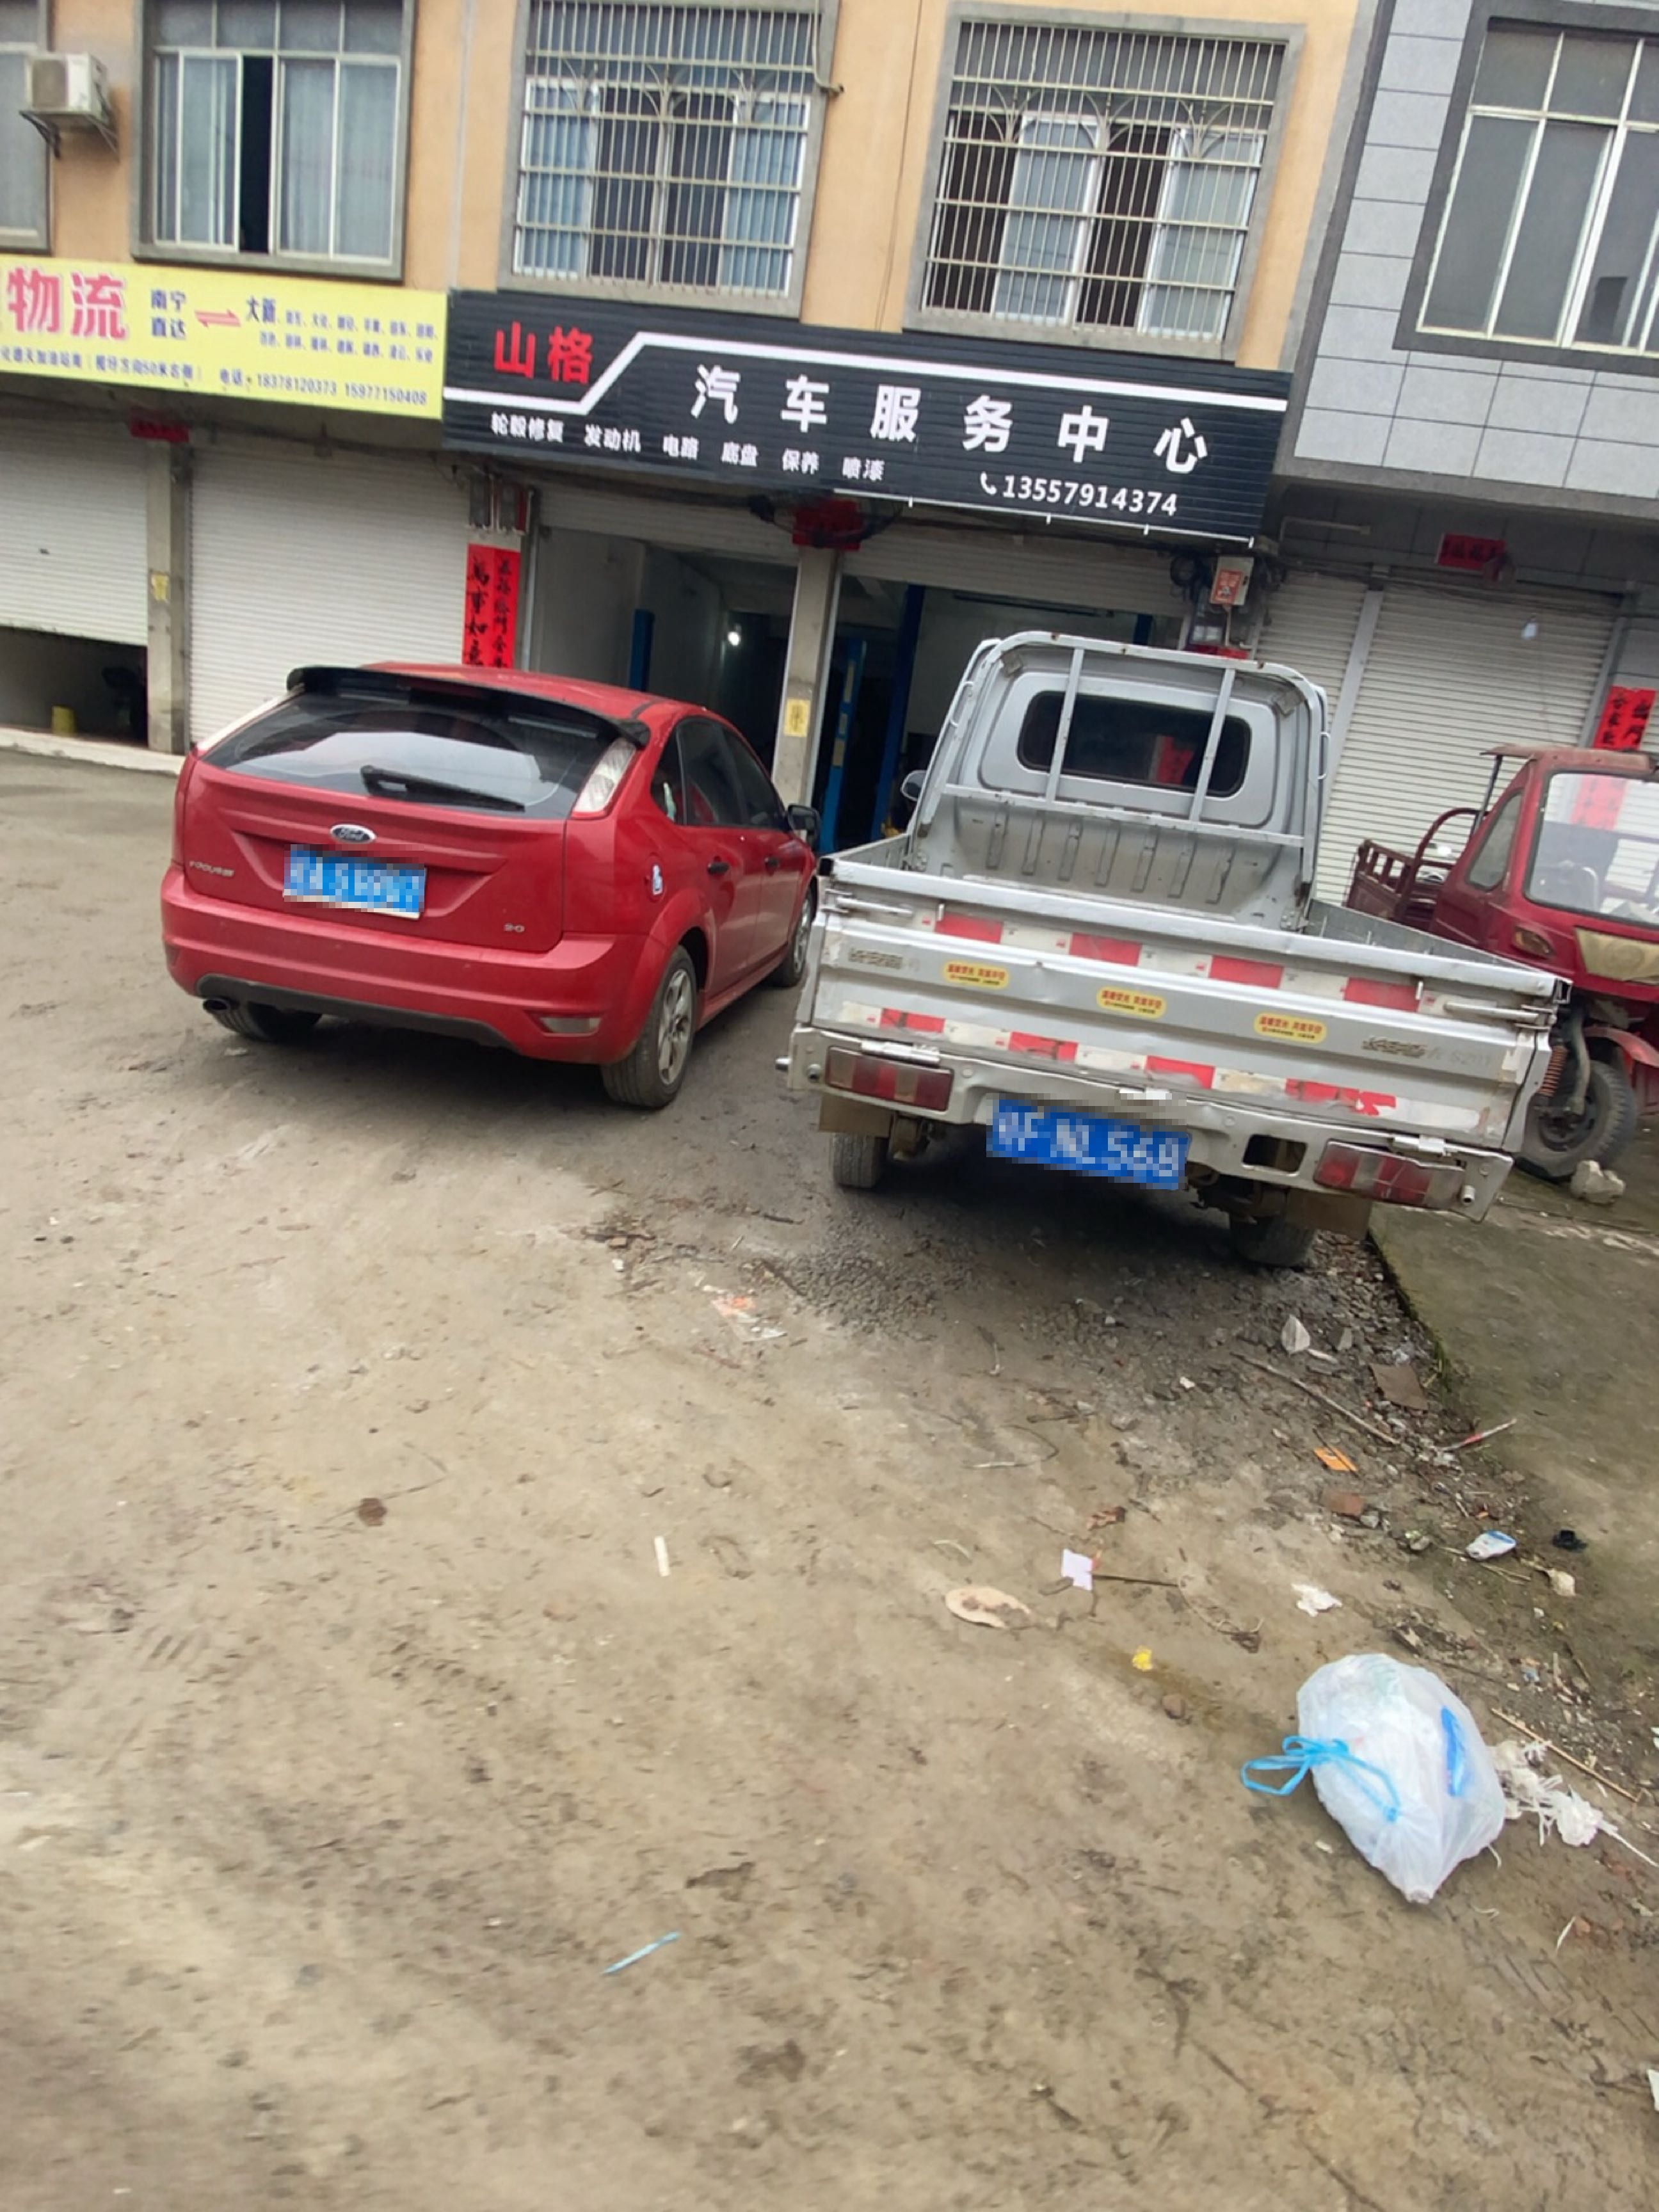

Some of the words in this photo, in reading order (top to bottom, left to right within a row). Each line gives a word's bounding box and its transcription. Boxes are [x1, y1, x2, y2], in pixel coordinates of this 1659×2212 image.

[8, 268, 126, 339] 物流
[151, 290, 186, 312] 南宁
[152, 316, 186, 340] 直达
[494, 321, 593, 385] 山格
[491, 411, 565, 443] 轮毂修复
[584, 424, 641, 453] 发动机
[662, 434, 700, 460] 电路
[721, 442, 758, 467] 底盘
[781, 448, 820, 475] 保养
[842, 457, 885, 481] 喷漆
[691, 364, 1208, 474] 汽车服务中心
[1002, 474, 1178, 517] 13557914374
